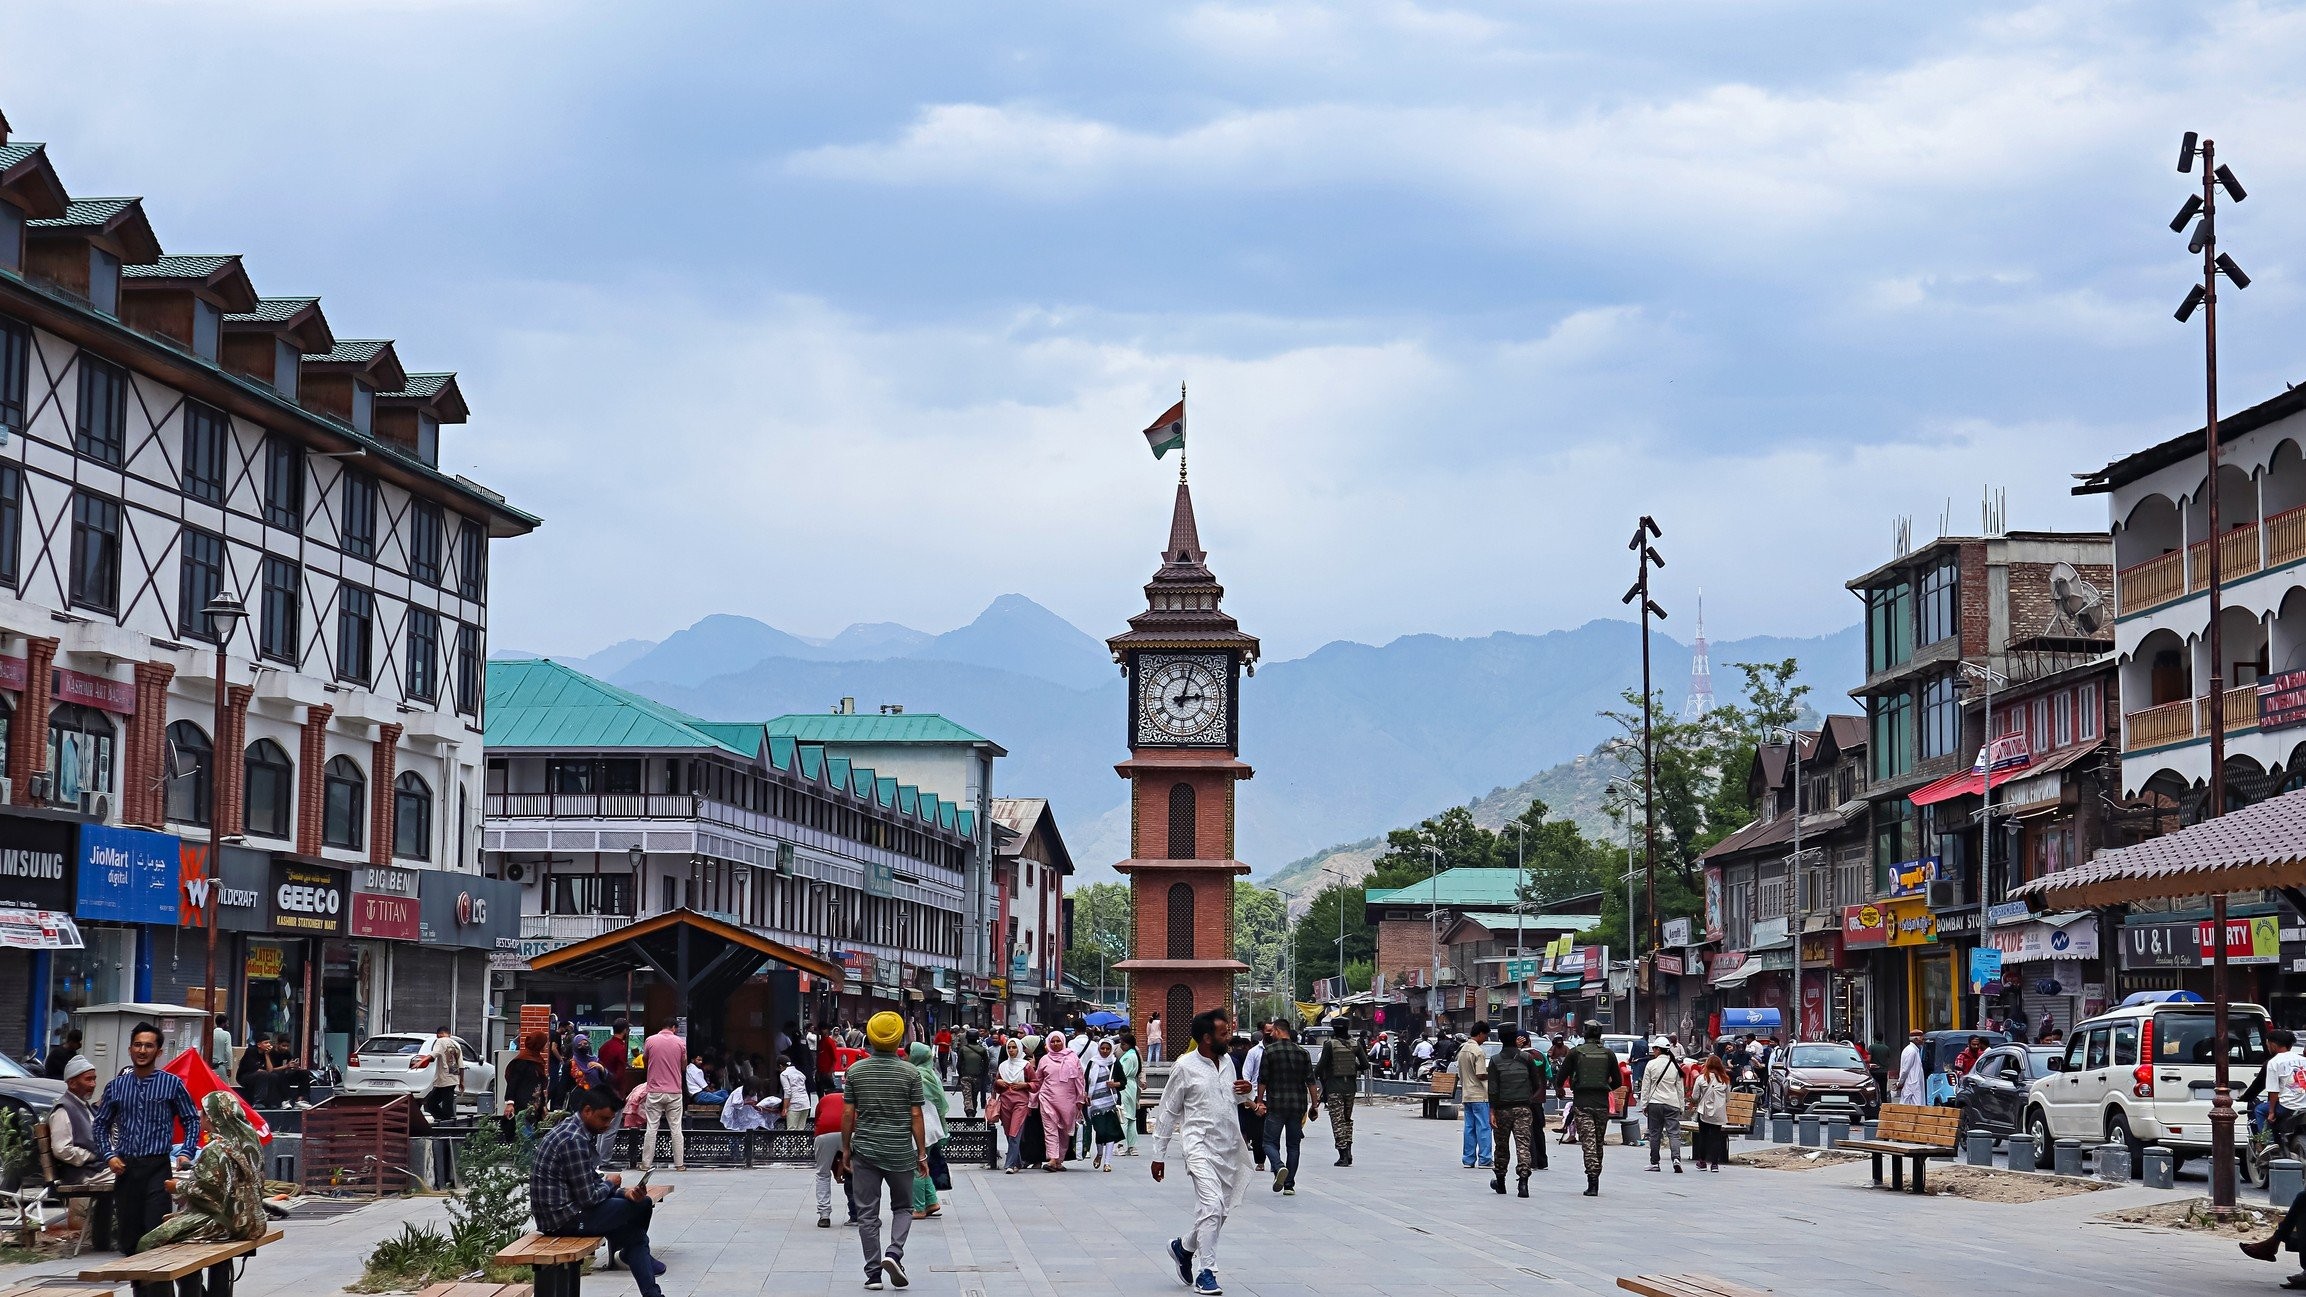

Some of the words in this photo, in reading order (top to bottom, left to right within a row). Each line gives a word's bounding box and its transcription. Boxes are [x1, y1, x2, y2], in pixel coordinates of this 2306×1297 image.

[95, 682, 107, 700] ART
[0, 849, 63, 880] MSUNG
[90, 846, 129, 868] JioMart
[108, 870, 128, 887] digital
[367, 869, 386, 888] BIG
[389, 871, 411, 892] BEN
[277, 883, 340, 915] GEECO
[379, 900, 407, 922] TITAN
[472, 898, 487, 924] LG
[276, 915, 297, 927] KASHMIR
[298, 917, 323, 930] STATIONERY
[324, 919, 337, 931] MART
[1936, 917, 1964, 933] BOMBAY
[1967, 914, 1981, 929] STO
[1994, 928, 2025, 953] EXIDE
[2134, 929, 2145, 955] U
[2151, 929, 2163, 955] &
[2166, 929, 2172, 955] I
[2202, 925, 2247, 947] LIRTY
[255, 948, 276, 962] LATEST
[2155, 955, 2174, 965] Academy
[2174, 955, 2180, 965] Of
[248, 960, 263, 976] dding
[1491, 1004, 1498, 1013] P
[1600, 996, 1607, 1005] P
